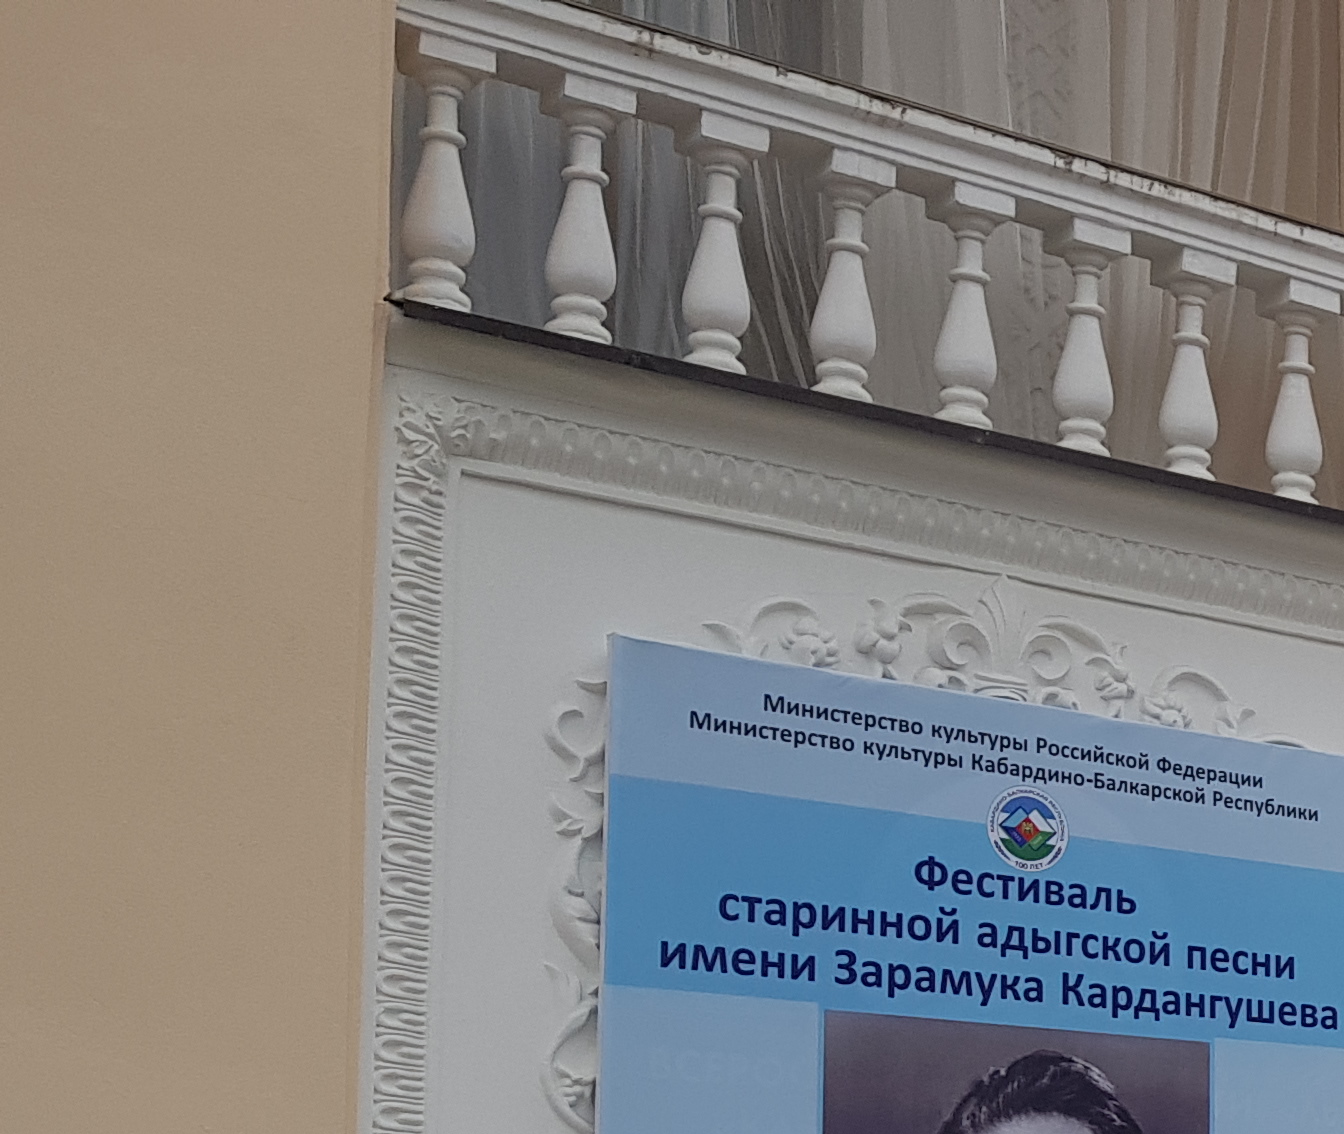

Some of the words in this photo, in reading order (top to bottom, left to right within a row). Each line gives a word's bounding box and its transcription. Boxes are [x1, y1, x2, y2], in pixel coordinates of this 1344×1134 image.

[690, 710, 854, 751] Министерство
[863, 740, 963, 769] культуры
[971, 754, 1205, 805] Кабардино-Балкарской
[1213, 791, 1319, 822] Республики
[763, 694, 923, 735] Министерство
[931, 722, 1028, 751] культуры
[1036, 737, 1149, 771] Российской
[1157, 757, 1263, 789] Федерации
[914, 856, 1137, 914] Фестиваль
[1014, 860, 1028, 870] 100
[1029, 862, 1044, 870] ЛЕТ
[718, 893, 959, 944] старинной
[977, 921, 1171, 967] адыгской
[1187, 944, 1295, 980] песни
[660, 940, 816, 981] имени
[834, 949, 1044, 1006] Зарамука
[1062, 972, 1338, 1031] Кардангушева
